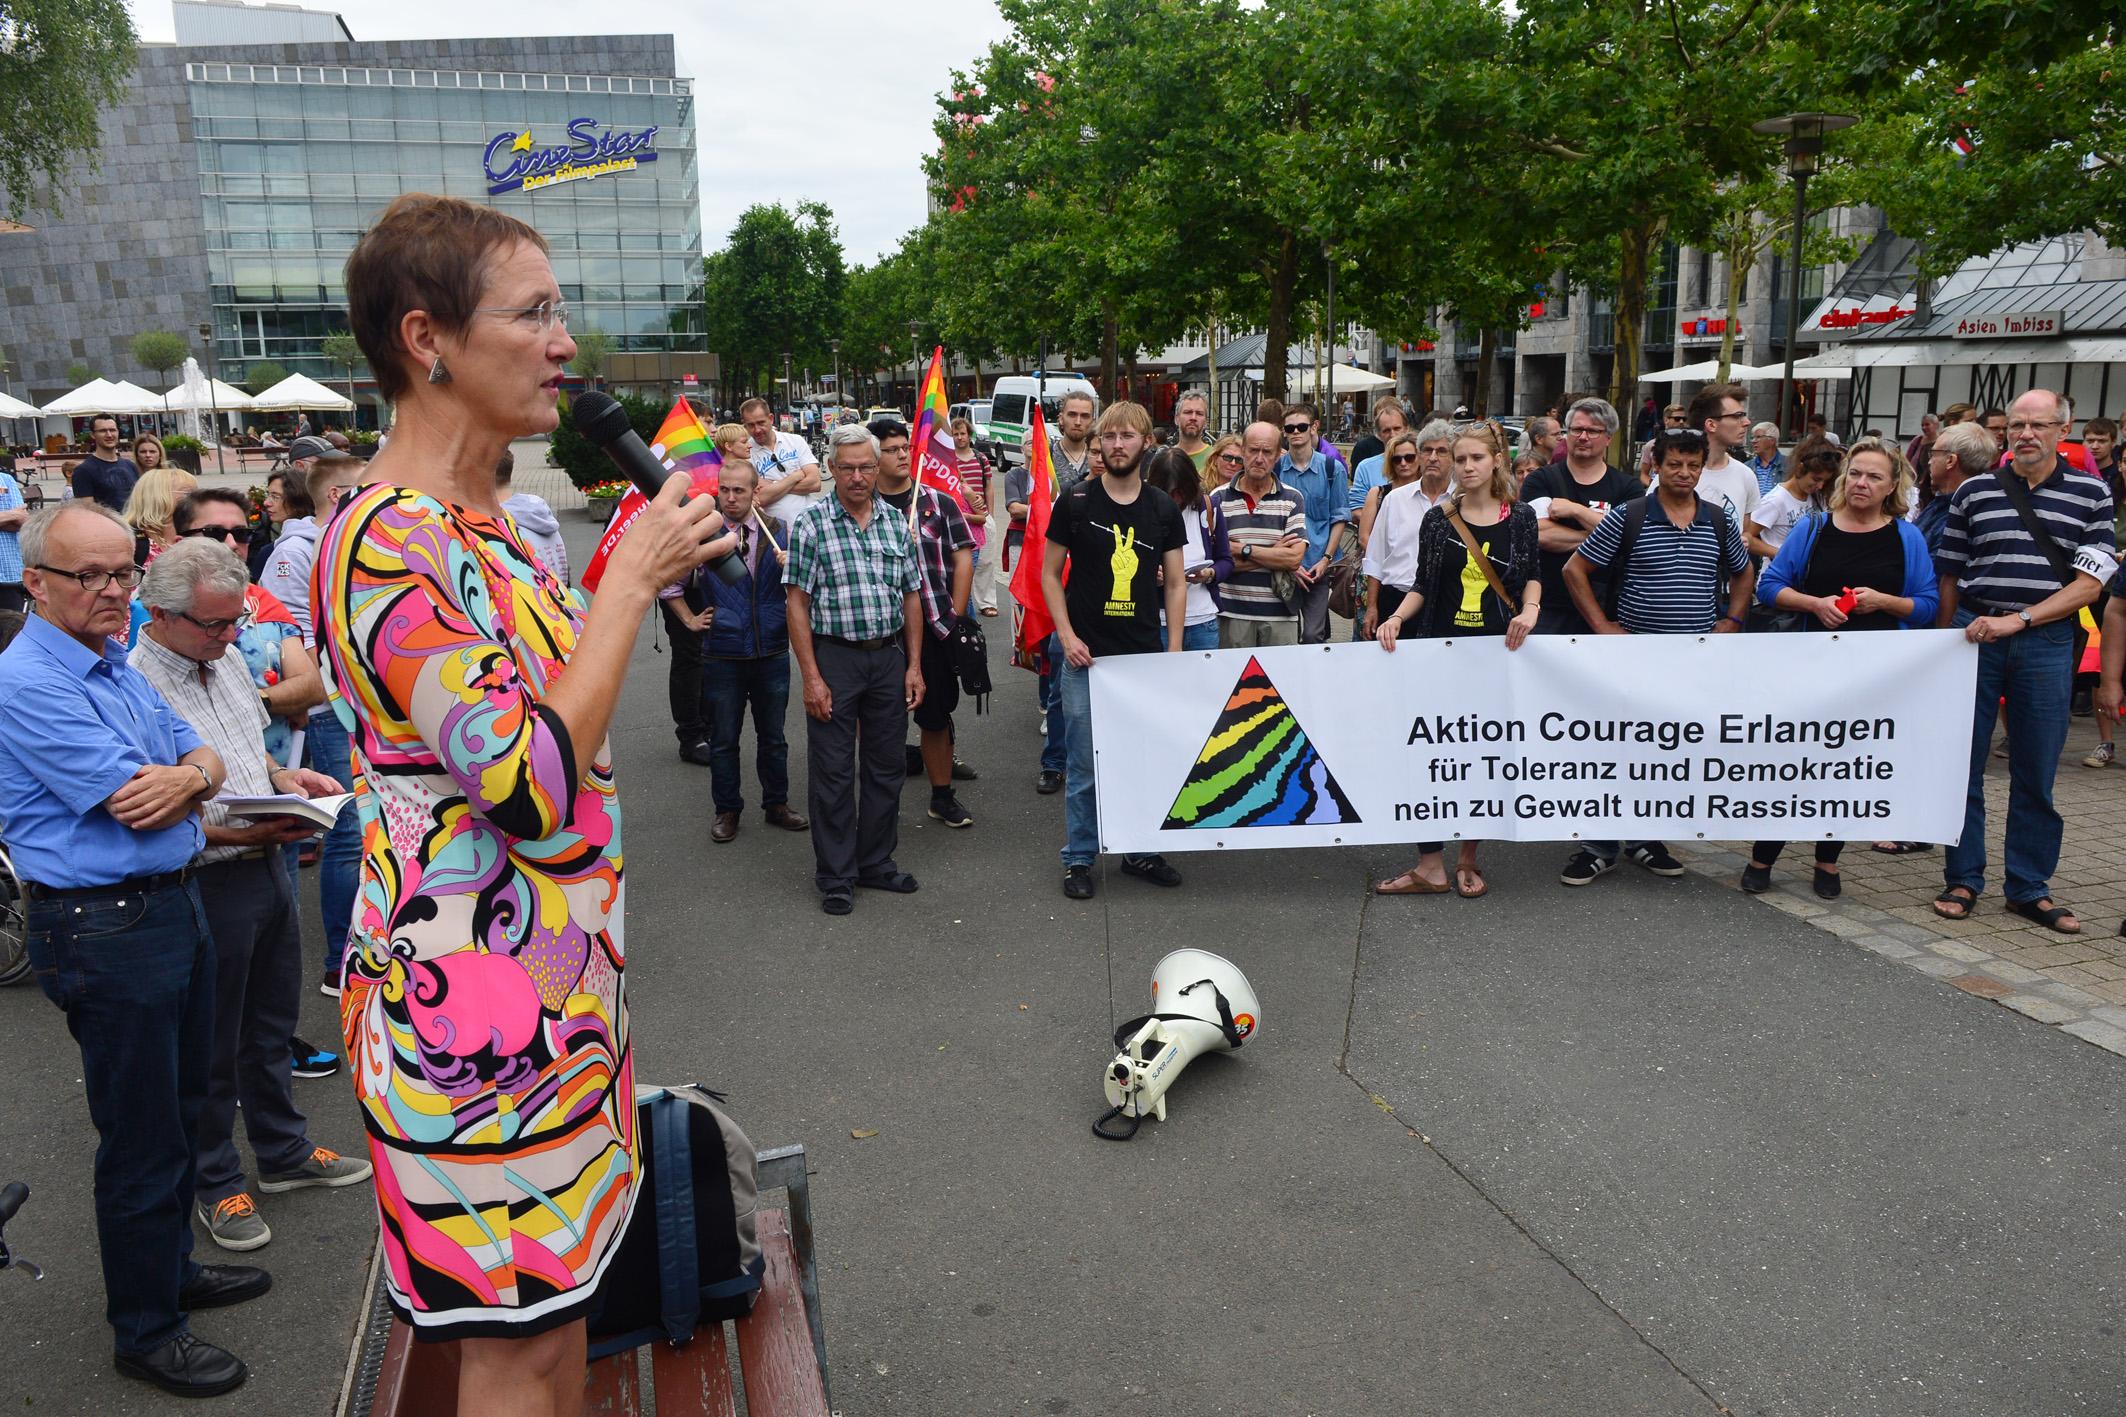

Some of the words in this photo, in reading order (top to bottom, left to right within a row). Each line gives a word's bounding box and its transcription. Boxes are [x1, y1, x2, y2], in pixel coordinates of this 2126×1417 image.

[483, 117, 659, 183] CineStar
[523, 173, 553, 190] Der
[555, 156, 636, 181] Filmpalast
[1957, 318, 1997, 334] Asien
[2004, 317, 2054, 333] Imbiss
[1104, 601, 1136, 611] AMNESTY
[1407, 713, 1525, 746] Aktion
[1539, 711, 1705, 751] Courage
[1719, 713, 1895, 750] Erlangen
[1428, 757, 1472, 783] für
[1481, 755, 1617, 781] Toleranz
[1629, 757, 1690, 782] und
[1703, 754, 1894, 782] Demokratie
[1394, 795, 1458, 821] nein
[1469, 799, 1504, 819] zu
[1514, 793, 1622, 819] Gewalt
[1633, 794, 1695, 819] und
[1707, 793, 1891, 819] Rassismus
[1152, 1061, 1167, 1081] SUPER
